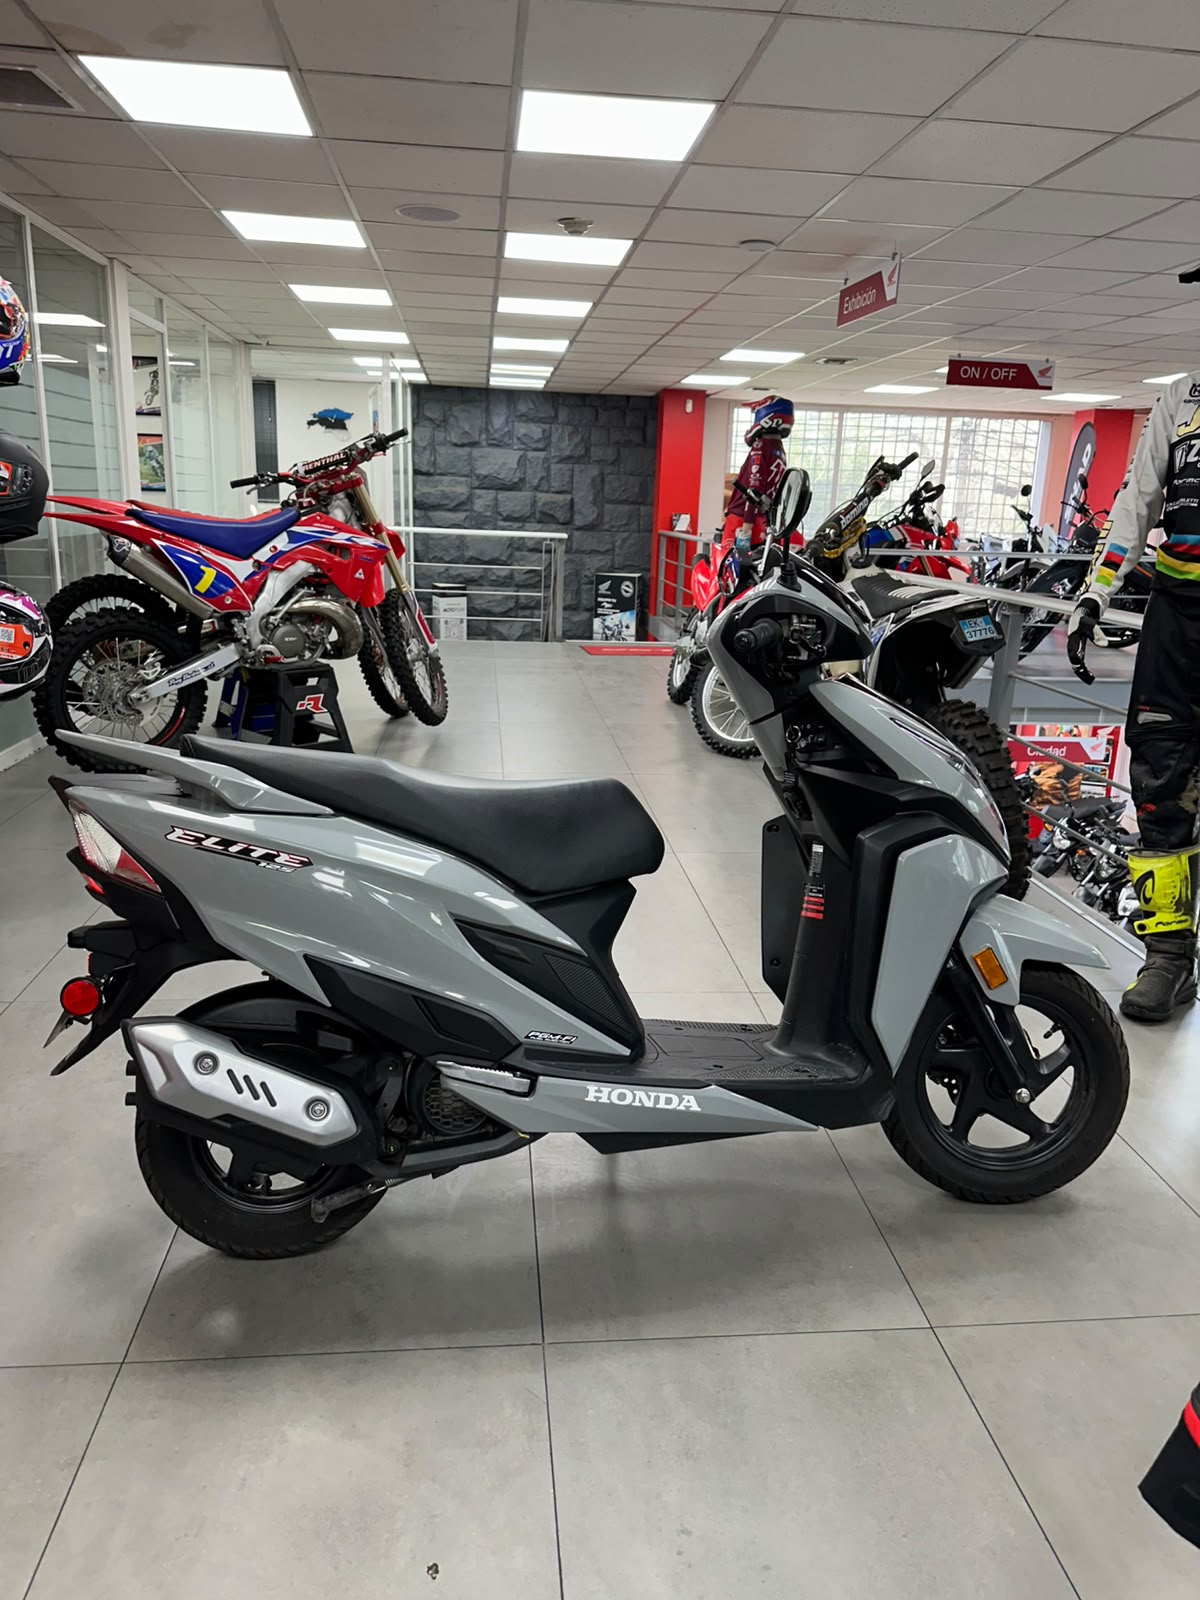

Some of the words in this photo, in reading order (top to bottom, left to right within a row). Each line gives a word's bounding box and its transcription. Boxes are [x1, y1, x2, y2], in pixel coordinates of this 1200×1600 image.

[843, 286, 877, 315] Exhibición
[960, 366, 980, 378] ON
[990, 367, 1018, 380] OFF
[303, 452, 346, 471] RENTHAL
[194, 565, 217, 594] 1
[966, 627, 995, 639] 37776
[166, 827, 310, 868] ELITE
[584, 1085, 701, 1111] HONDA
